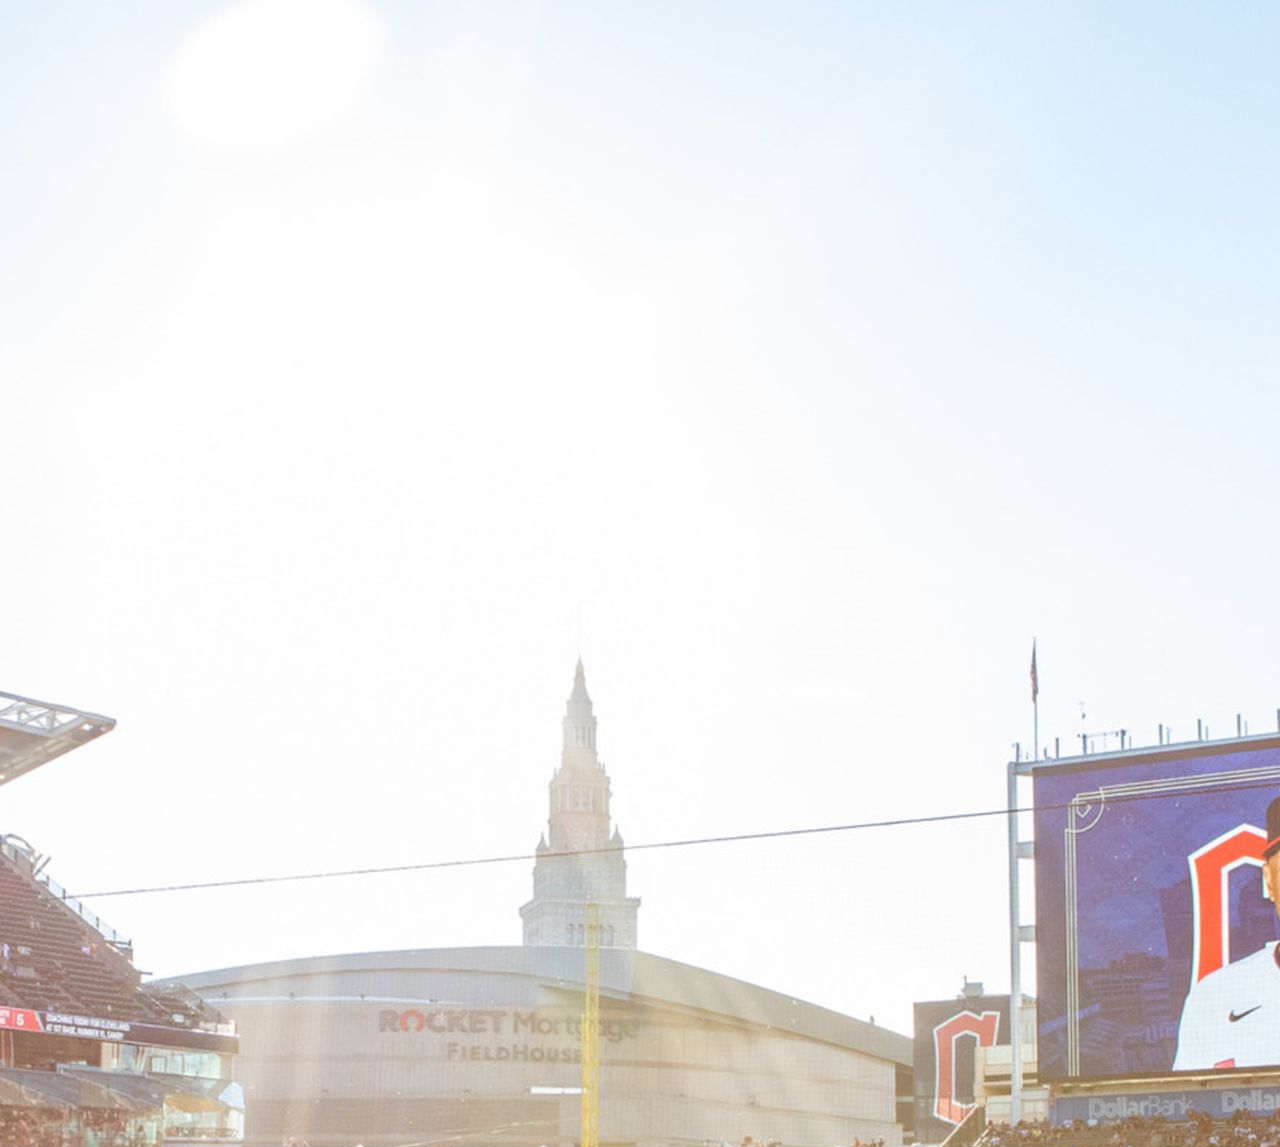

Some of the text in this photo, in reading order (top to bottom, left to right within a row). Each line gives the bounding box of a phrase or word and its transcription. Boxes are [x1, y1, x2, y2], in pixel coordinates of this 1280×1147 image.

[16, 1013, 24, 1026] 5
[378, 1009, 507, 1033] ROCKET
[1088, 1096, 1193, 1119] DollarBank
